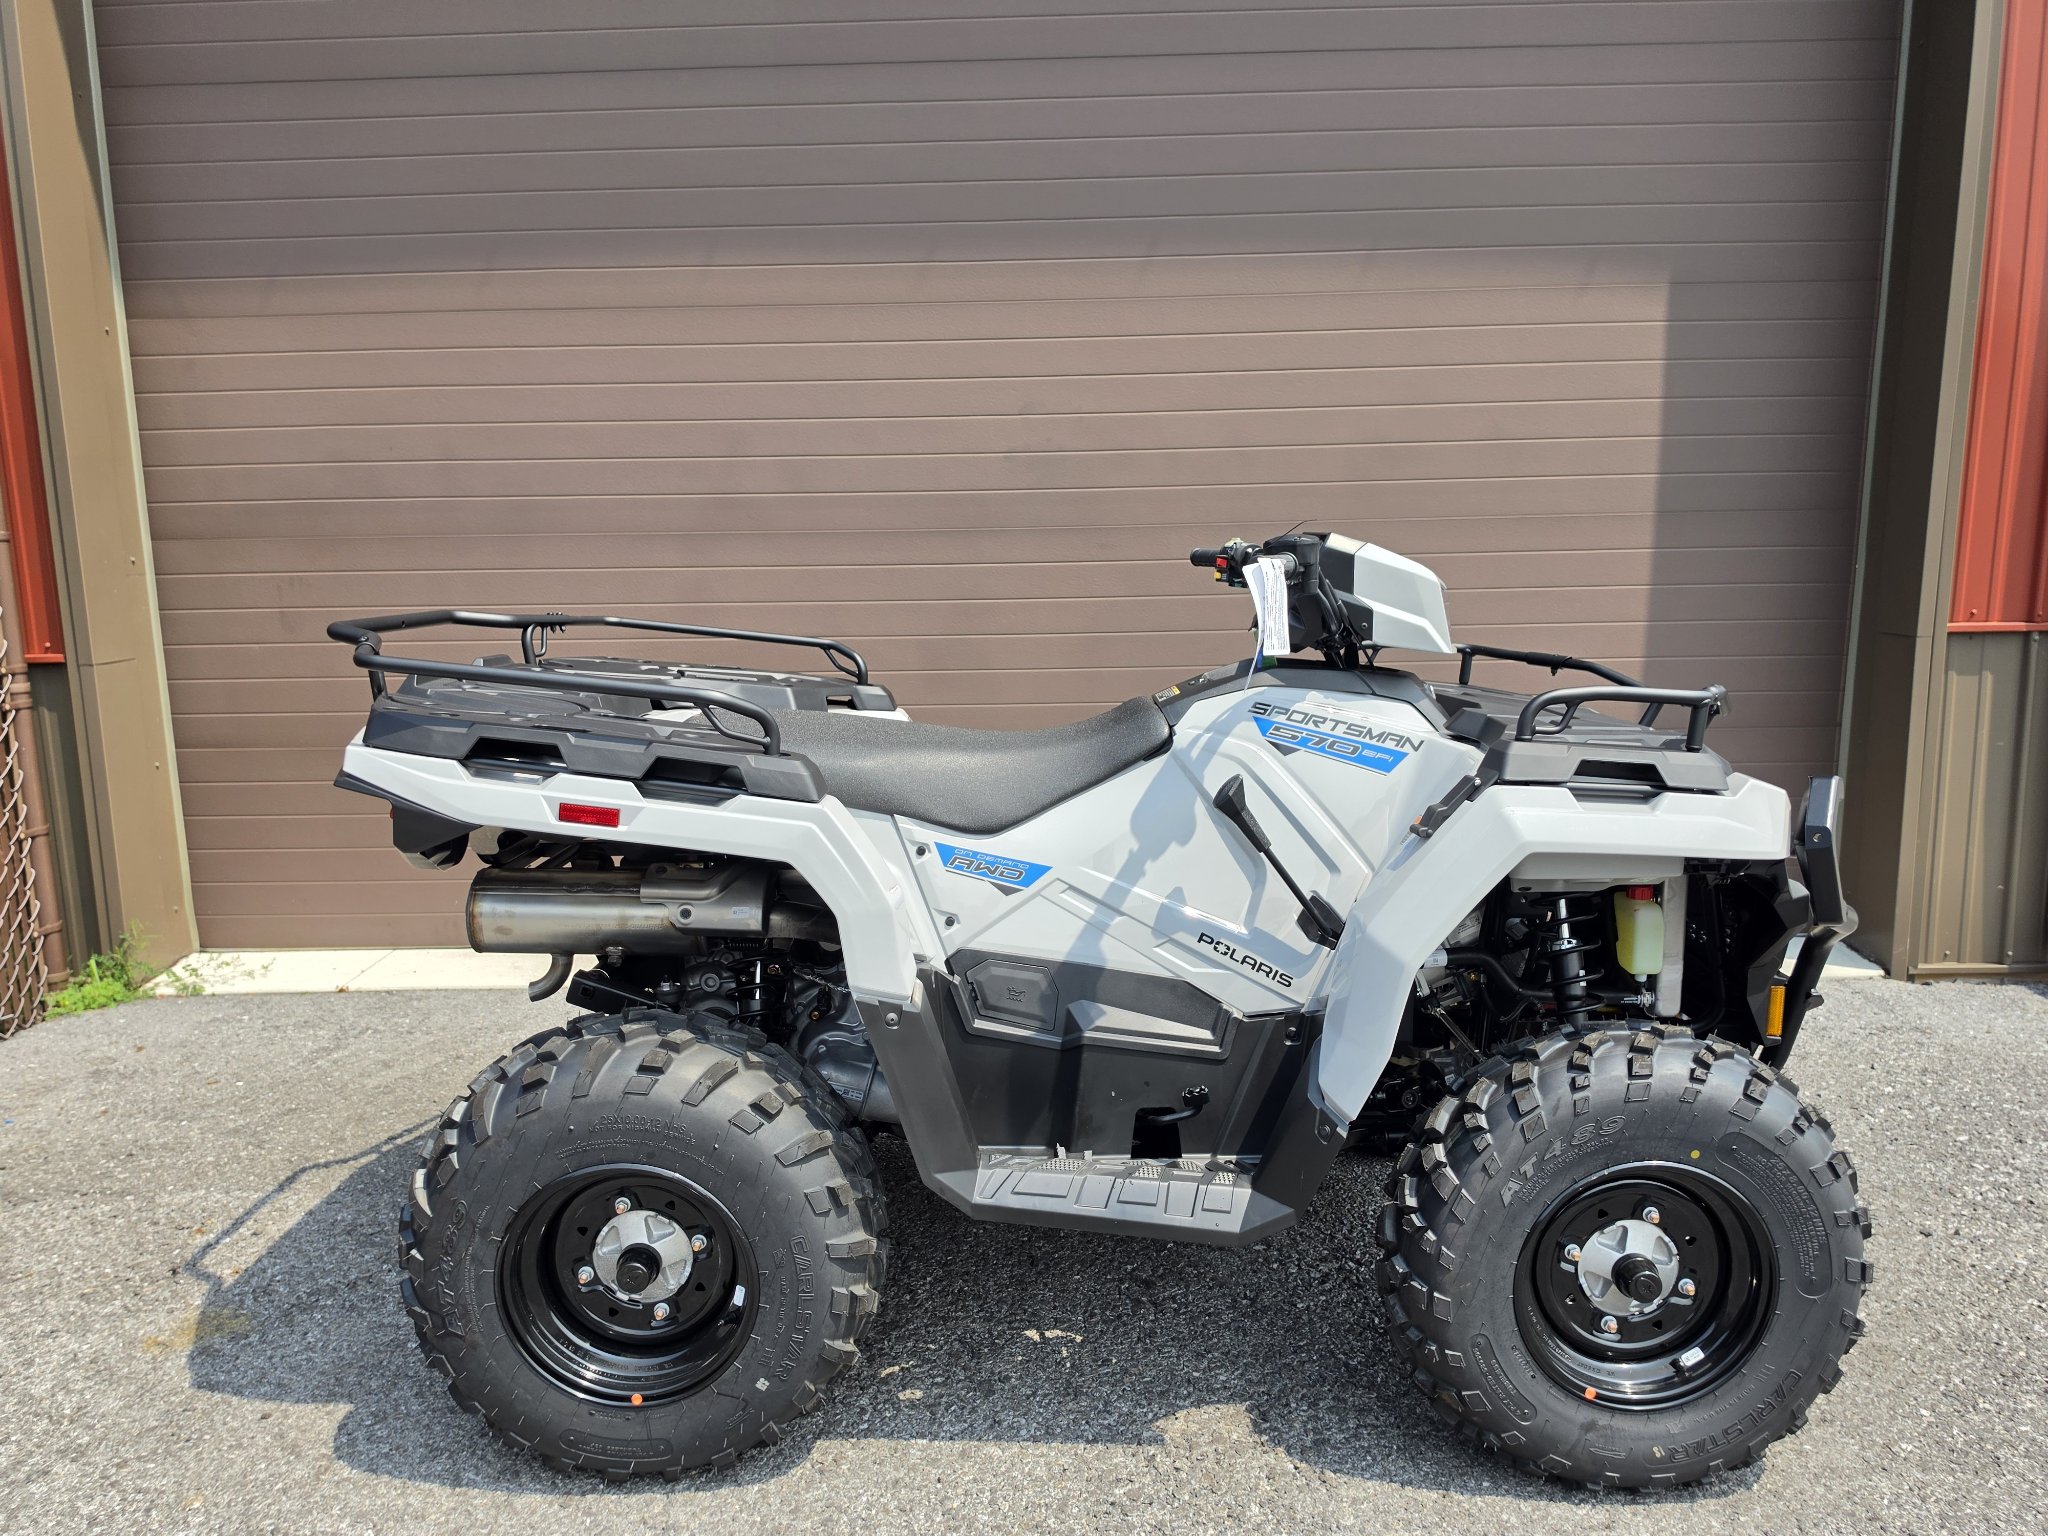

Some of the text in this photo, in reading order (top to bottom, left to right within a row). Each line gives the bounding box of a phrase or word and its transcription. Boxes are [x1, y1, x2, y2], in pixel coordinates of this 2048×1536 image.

[1248, 701, 1425, 753] SPORTSMAN
[1268, 725, 1362, 757] 570
[947, 854, 1026, 882] AWD
[954, 848, 1030, 870] ON DEMAND
[1197, 931, 1294, 988] POLARIS
[1667, 1368, 1802, 1463] CARLSTAR
